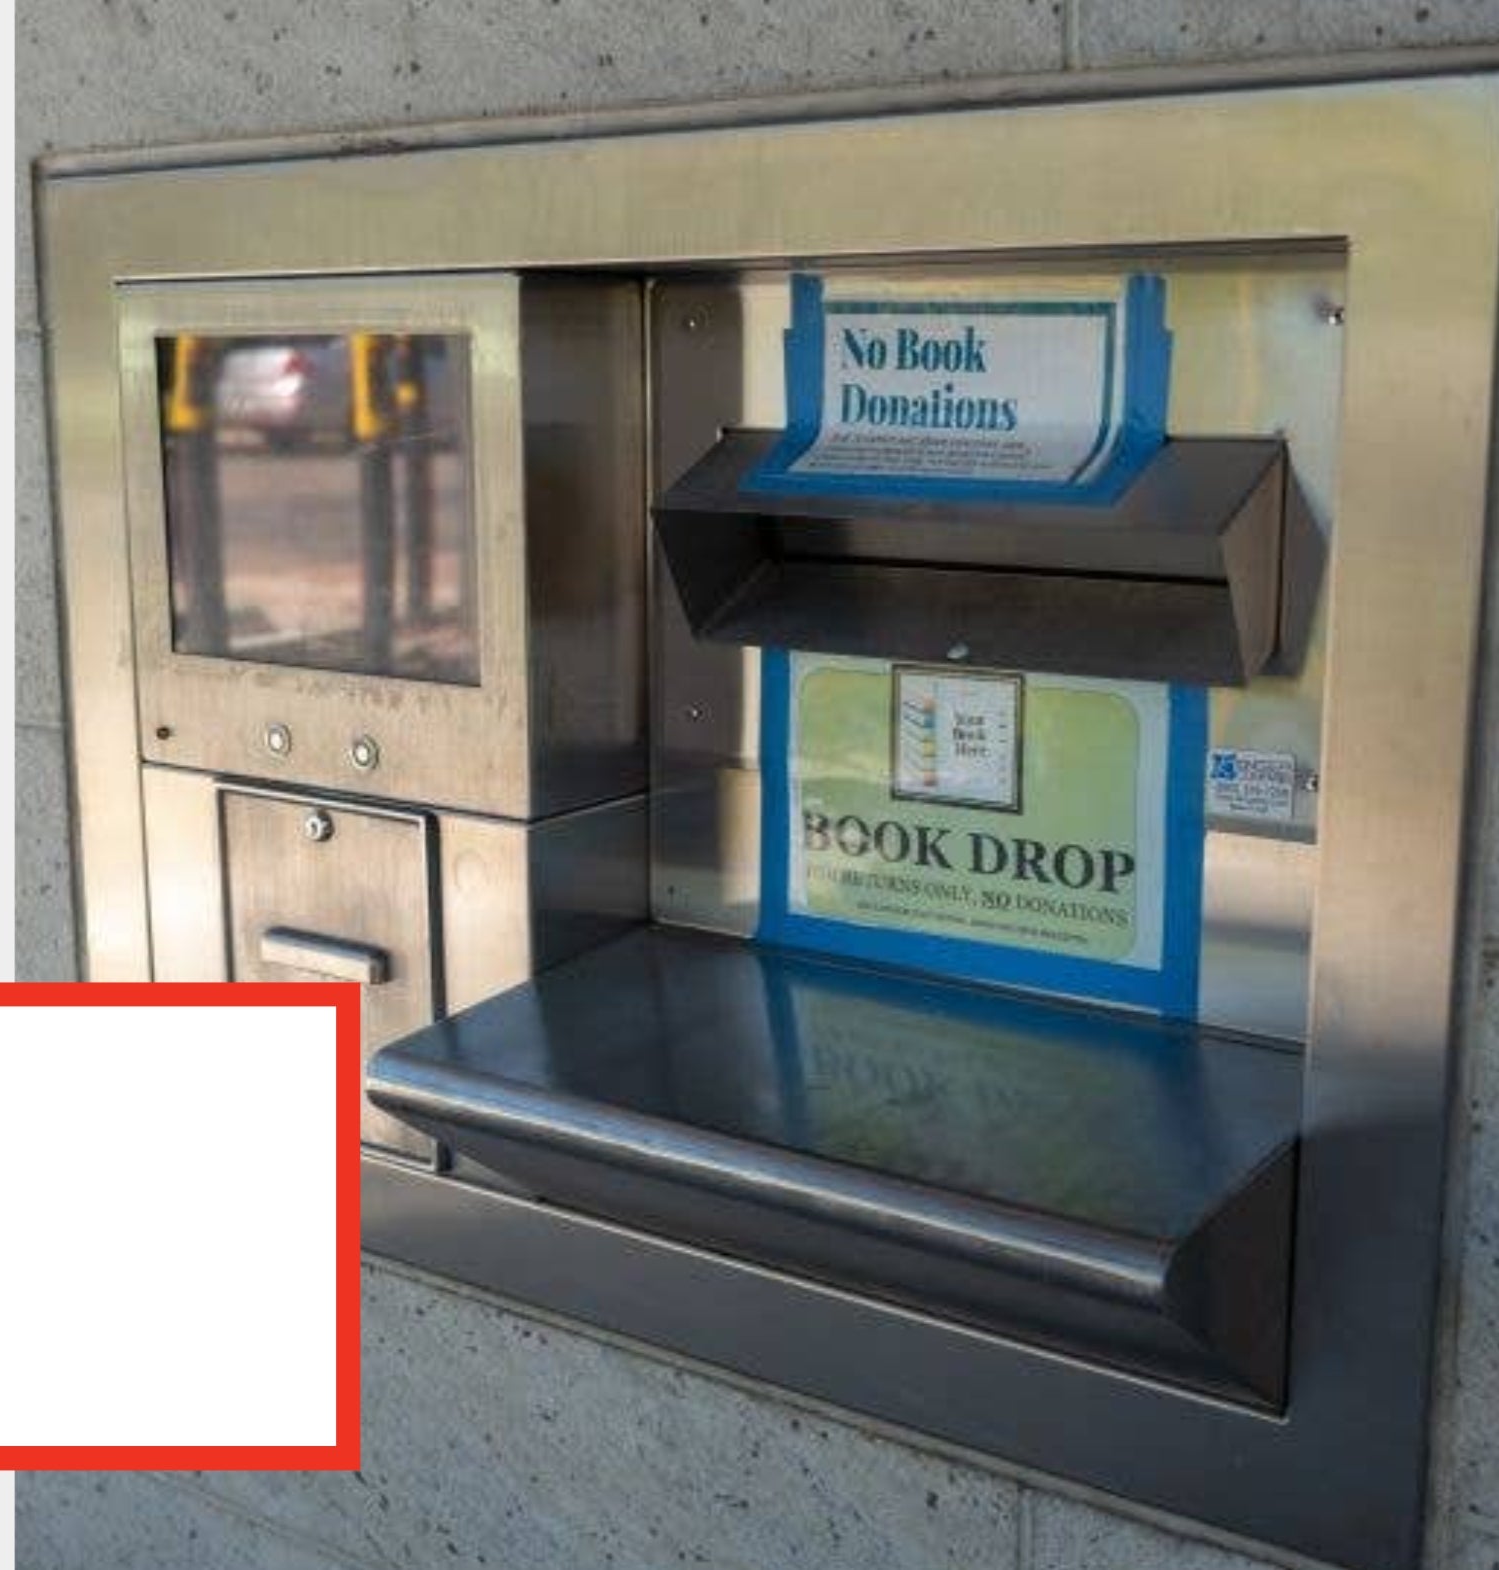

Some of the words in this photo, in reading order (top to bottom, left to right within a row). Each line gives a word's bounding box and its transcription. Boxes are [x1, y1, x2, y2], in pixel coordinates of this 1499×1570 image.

[842, 326, 887, 371] No
[896, 325, 987, 374] Book
[841, 381, 1019, 432] Donations
[802, 810, 953, 872] BOOK
[967, 832, 1136, 894] DROP
[841, 868, 921, 895] RETURNS
[981, 890, 1012, 910] NO
[1016, 893, 1129, 927] DONATIONS
